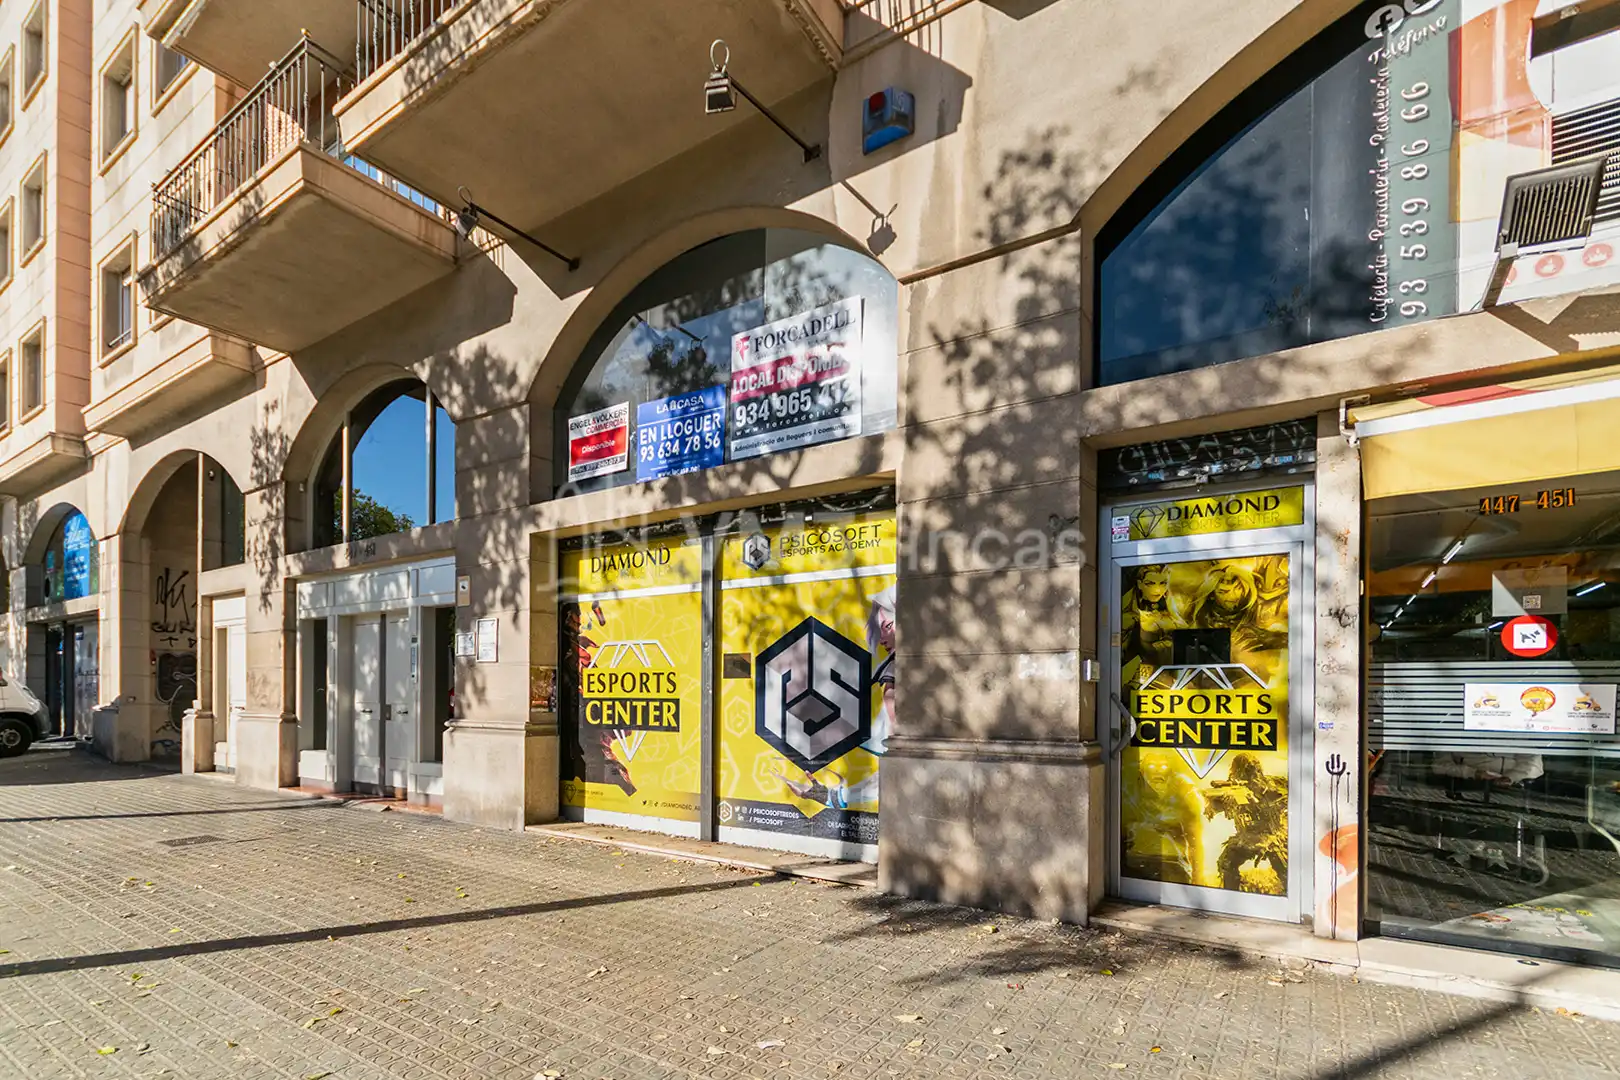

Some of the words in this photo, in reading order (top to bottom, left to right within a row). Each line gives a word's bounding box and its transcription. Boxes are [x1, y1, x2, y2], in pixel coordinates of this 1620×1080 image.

[1400, 81, 1429, 120] 66
[1400, 139, 1429, 179] 86
[1400, 197, 1428, 258] 539
[1400, 278, 1427, 316] 93
[754, 309, 856, 353] FORCADELL
[732, 370, 775, 396] LOCAL
[736, 398, 770, 428] 934
[775, 387, 812, 418] 965
[586, 418, 627, 435] COMMERCIAL
[640, 427, 657, 446] EN
[660, 413, 721, 438] LLOGUER
[776, 435, 785, 443] de
[581, 439, 616, 454] Disponible
[640, 445, 655, 463] 93
[657, 438, 681, 459] 634
[684, 435, 701, 454] 78
[704, 431, 721, 450] 56
[1167, 495, 1280, 521] DIAMOND
[1167, 517, 1222, 533] ESPORTS
[1225, 511, 1282, 529] CENTER
[780, 523, 882, 550] PSICOSOFT
[780, 544, 827, 559] ESPORTS
[827, 538, 882, 554] ACADEMY
[591, 546, 671, 573] DIAMOND
[586, 670, 678, 695] ESPORTS
[585, 699, 678, 728] CENTER
[1136, 693, 1273, 715] ESPORTS
[1136, 720, 1274, 747] CENTER
